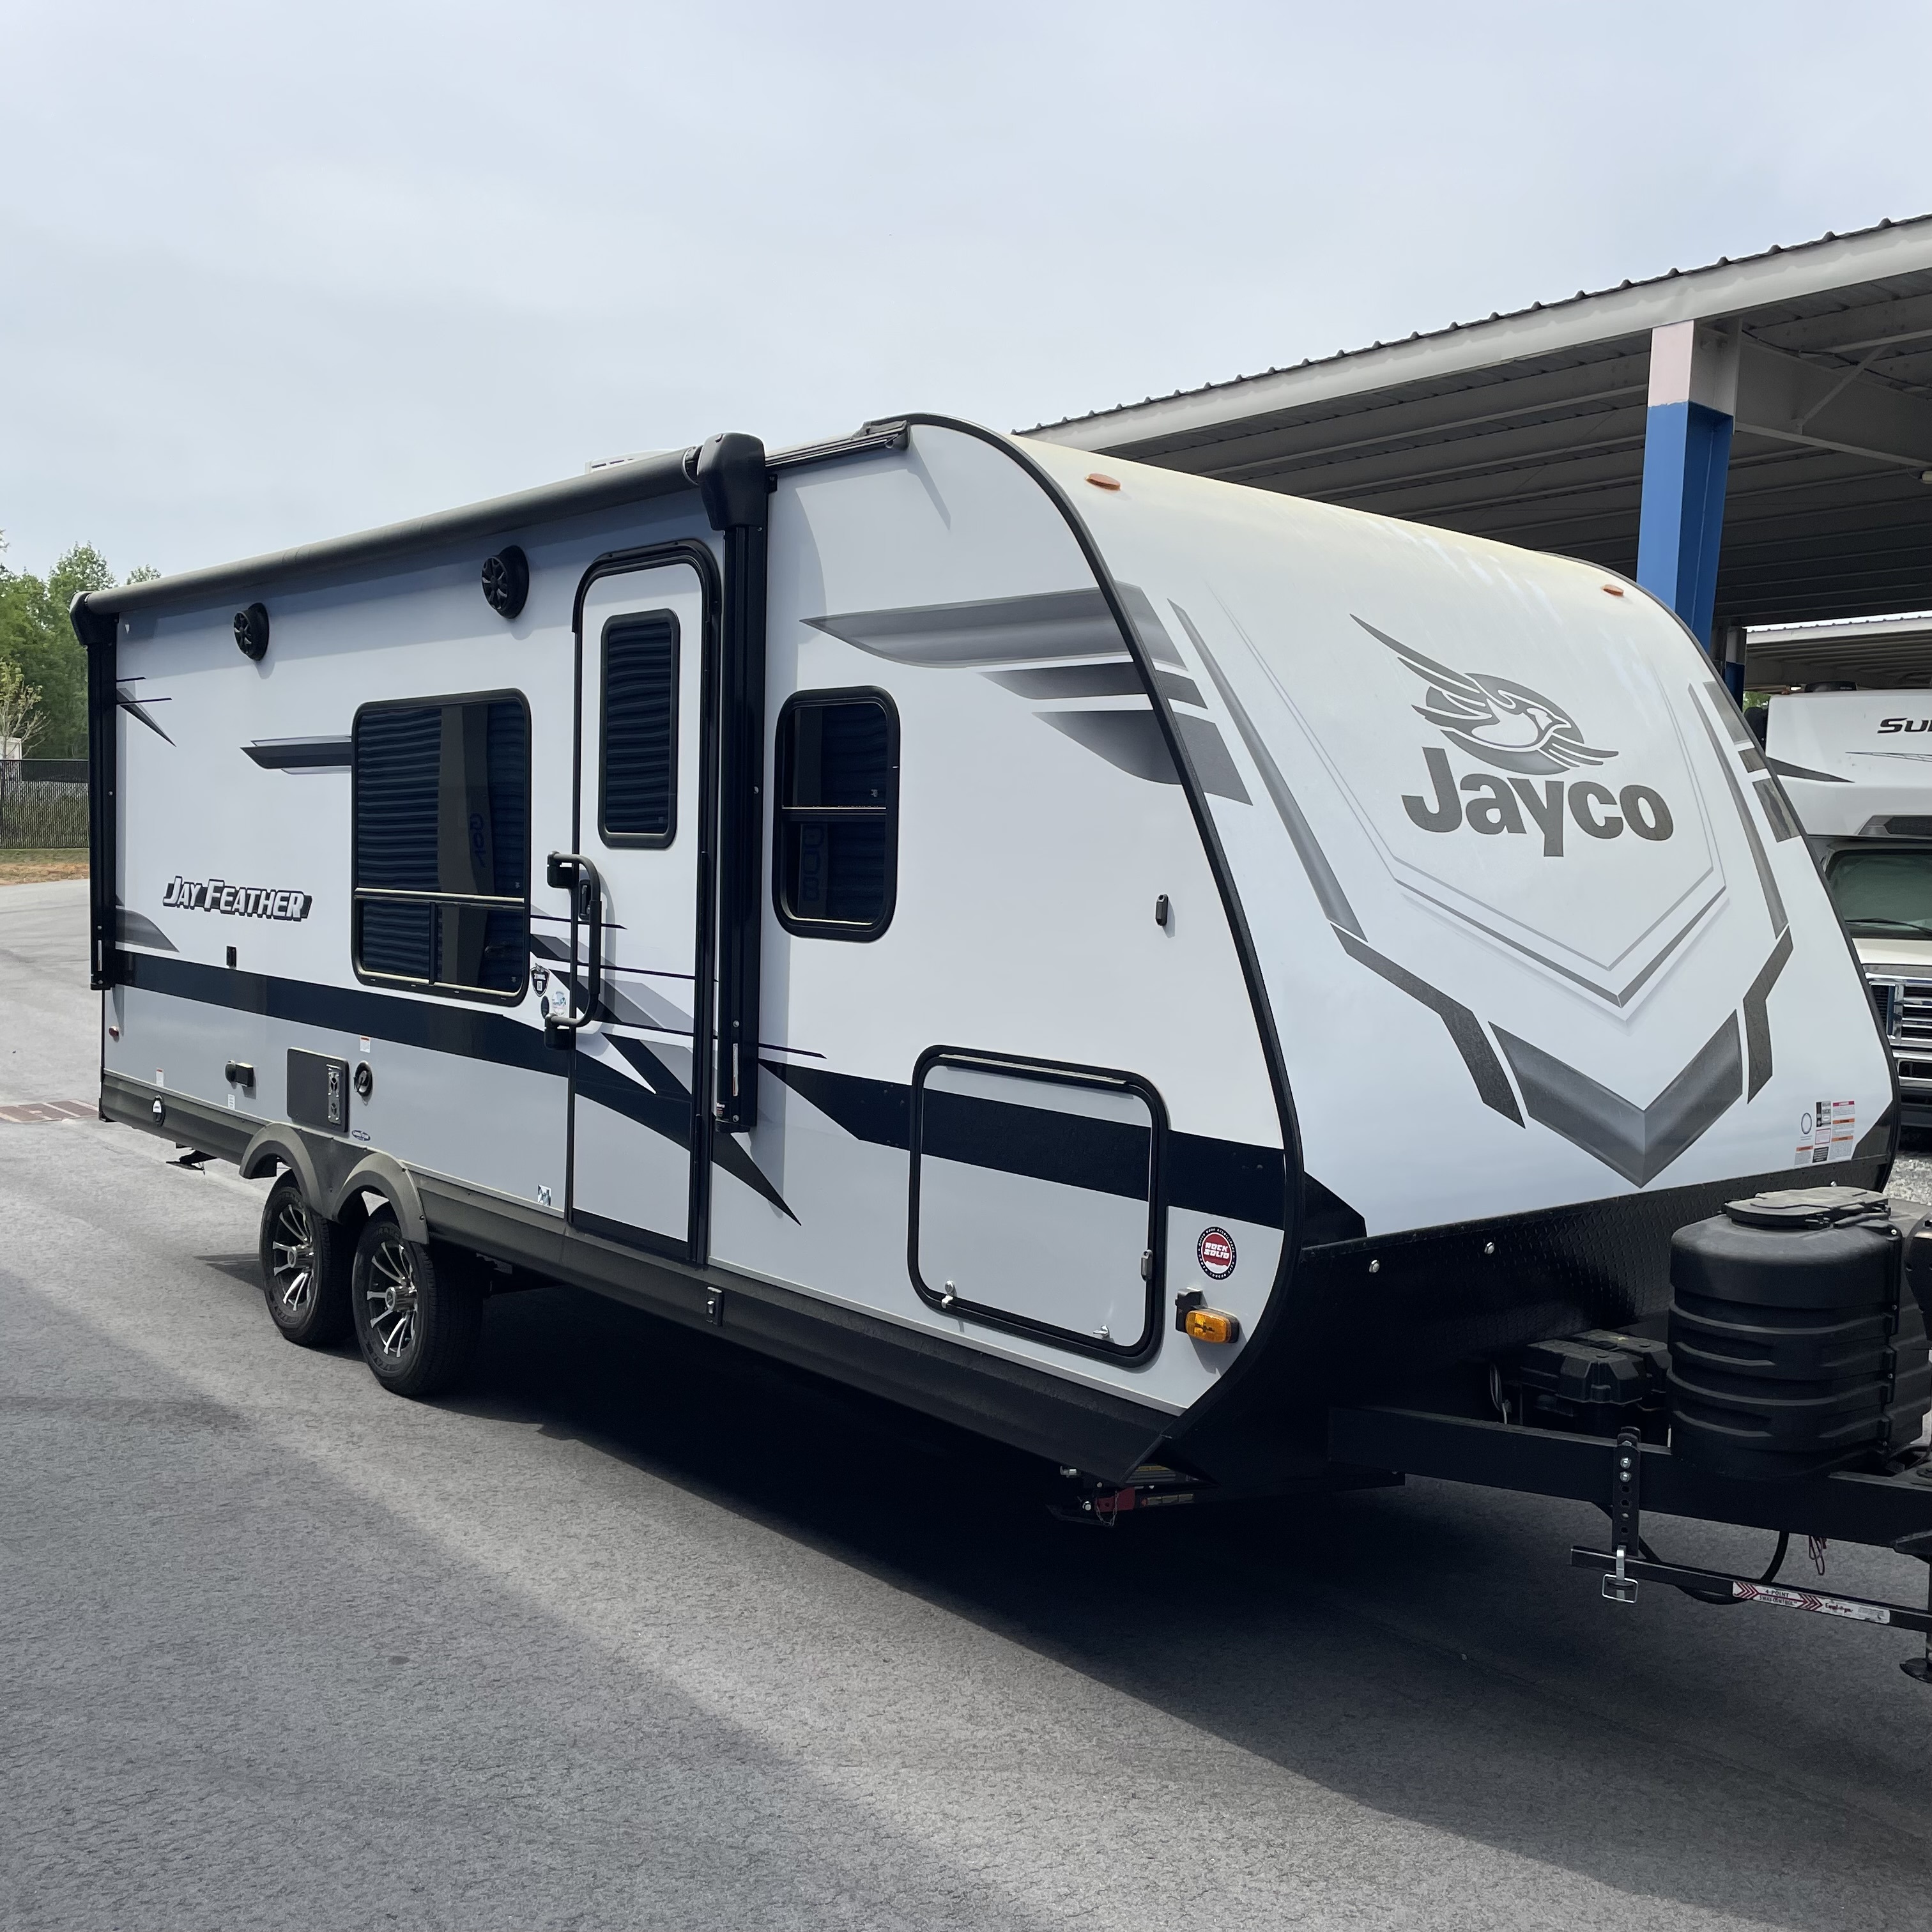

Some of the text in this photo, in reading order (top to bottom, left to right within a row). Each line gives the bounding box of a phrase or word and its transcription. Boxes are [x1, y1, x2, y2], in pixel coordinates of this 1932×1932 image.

[1877, 717, 1932, 733] SU
[1401, 746, 1674, 857] Jayco
[163, 875, 310, 922] JAY FEATHER
[1204, 1249, 1229, 1259] SOLID
[1205, 1242, 1229, 1252] ROCK
